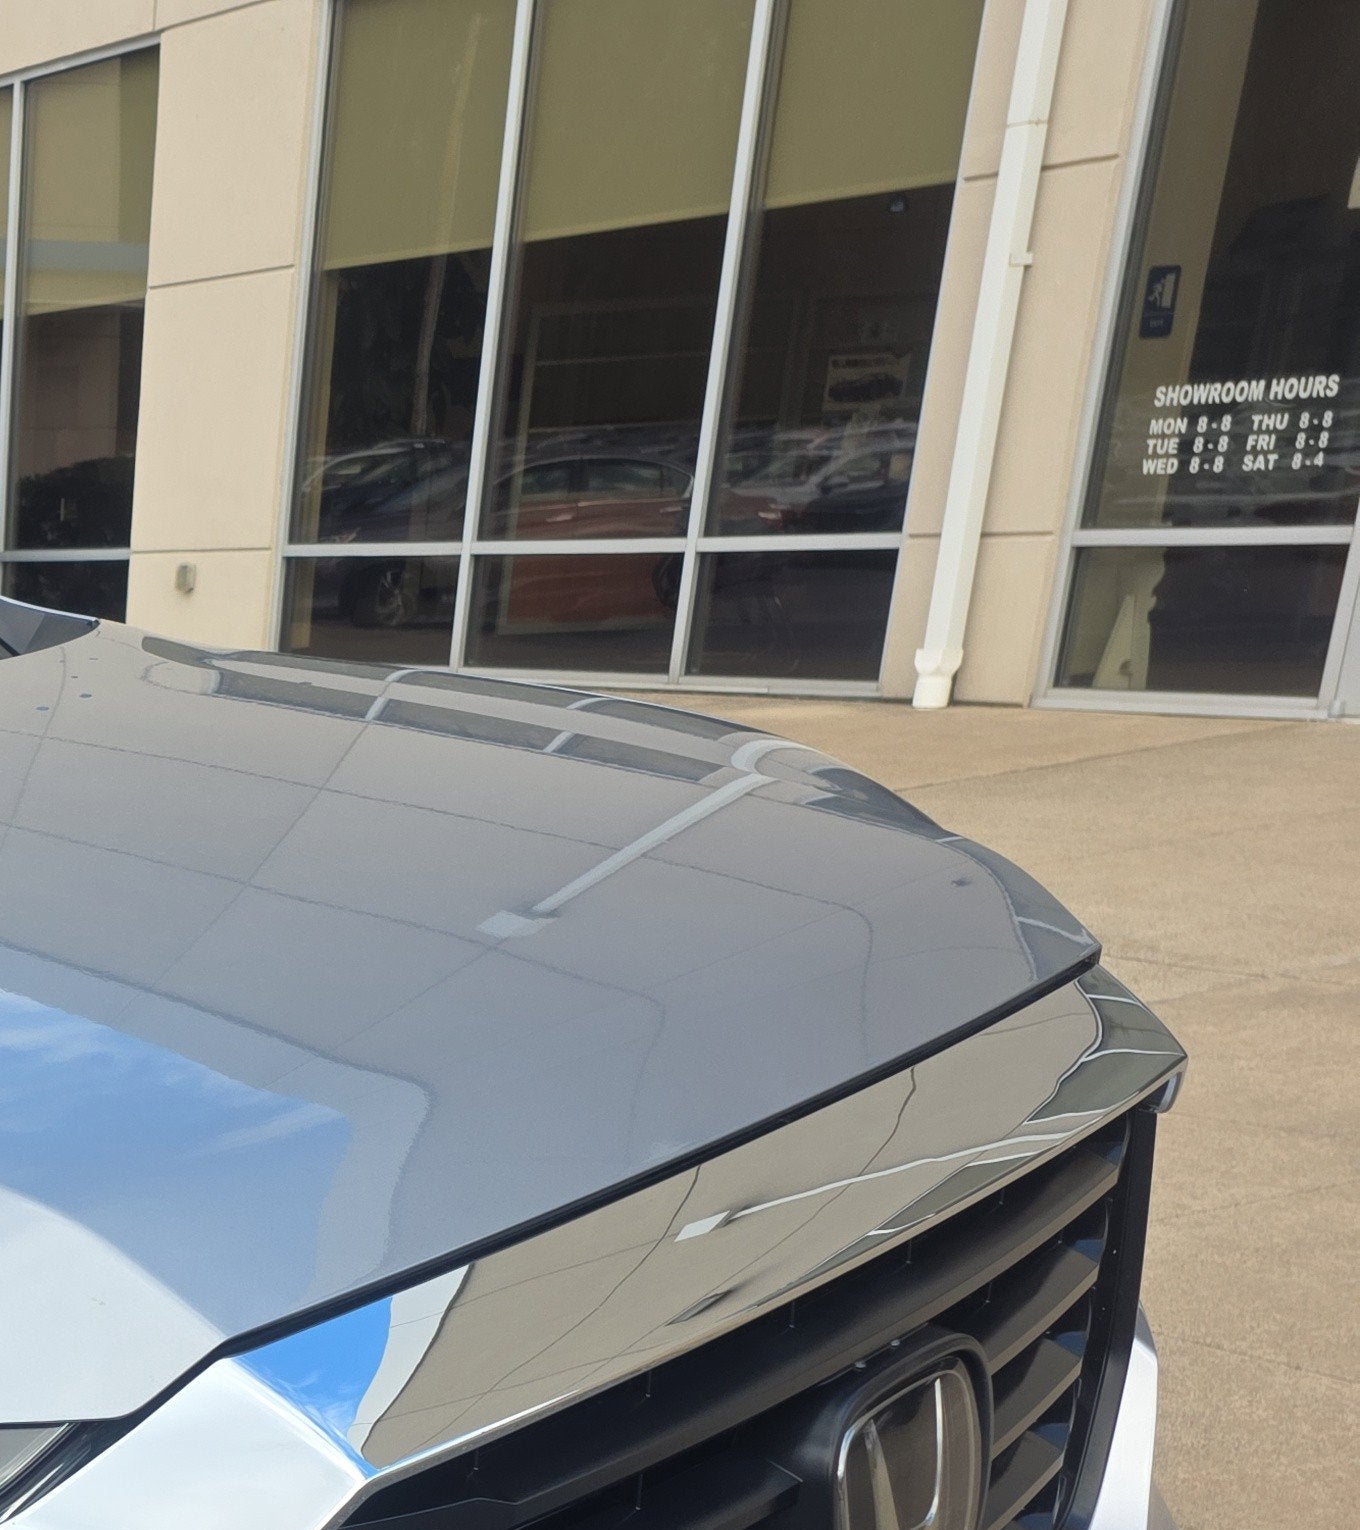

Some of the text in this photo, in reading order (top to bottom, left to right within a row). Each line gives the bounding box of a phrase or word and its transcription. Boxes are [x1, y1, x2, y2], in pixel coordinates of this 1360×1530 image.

[1153, 374, 1340, 408] SHOWROOM HOURS
[1148, 416, 1188, 435] MON
[1251, 412, 1290, 431] THU
[1146, 437, 1179, 455] TUE
[1246, 433, 1276, 452] FRI
[1142, 457, 1179, 476] WED
[1242, 453, 1279, 472] SAT
